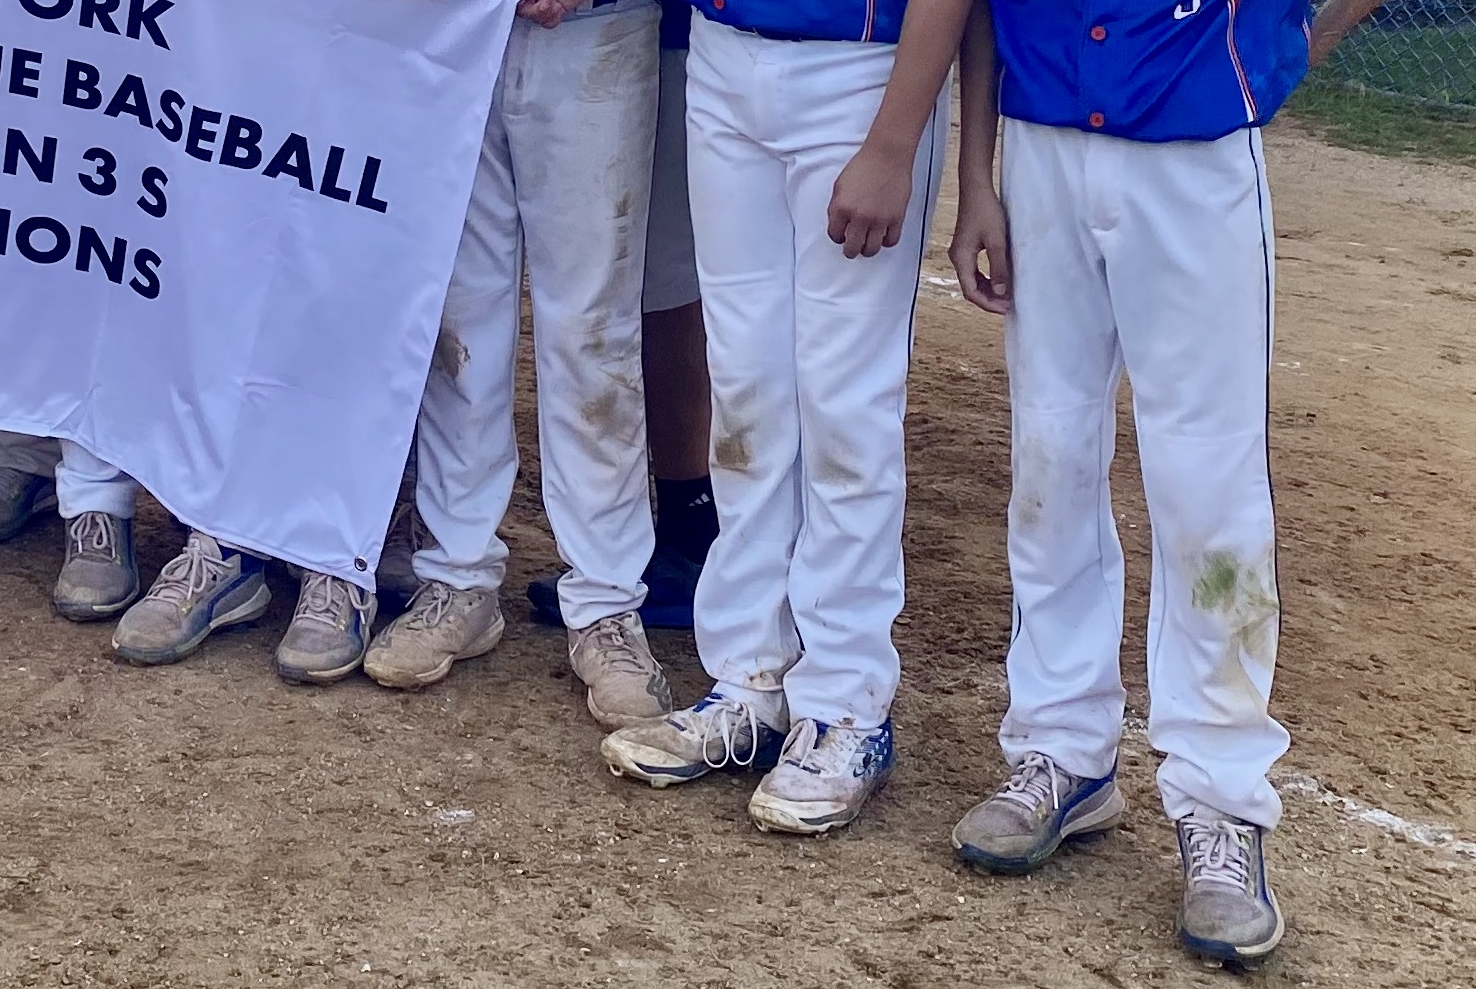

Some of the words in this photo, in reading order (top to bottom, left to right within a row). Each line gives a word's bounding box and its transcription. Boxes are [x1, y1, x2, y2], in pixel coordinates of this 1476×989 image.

[62, 59, 391, 214] BASEBALL
[78, 146, 119, 197] 3
[140, 167, 169, 219] S
